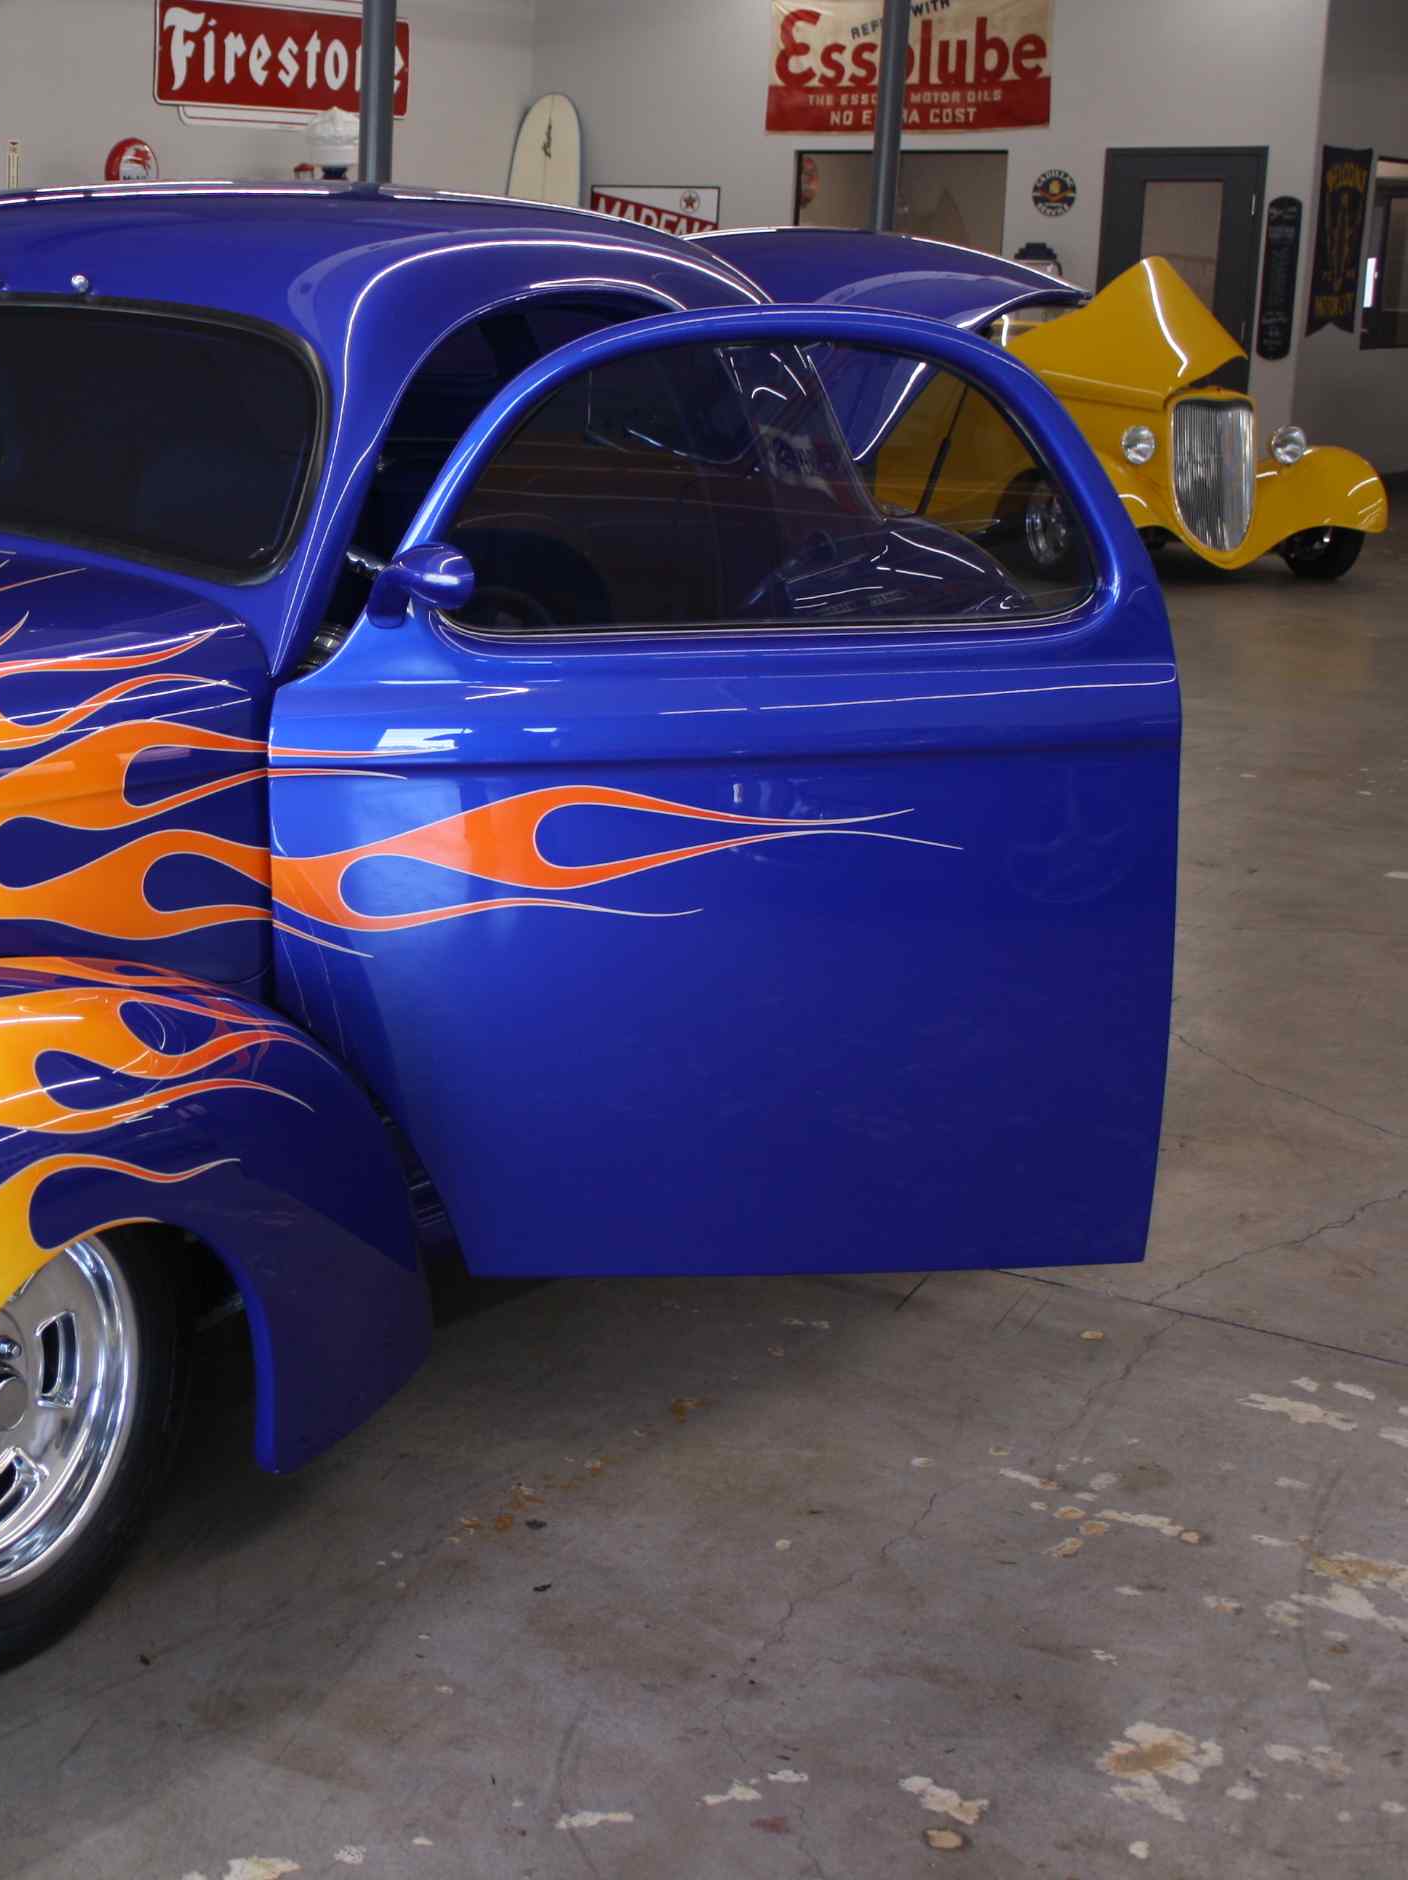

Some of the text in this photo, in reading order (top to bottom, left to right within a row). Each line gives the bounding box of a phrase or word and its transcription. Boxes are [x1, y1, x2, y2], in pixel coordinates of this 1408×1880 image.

[911, 0, 950, 17] WITH
[807, 94, 834, 106] THE
[910, 91, 961, 104] MOTOR
[966, 89, 1003, 103] OILS
[829, 109, 853, 126] NO
[928, 107, 978, 124] COST
